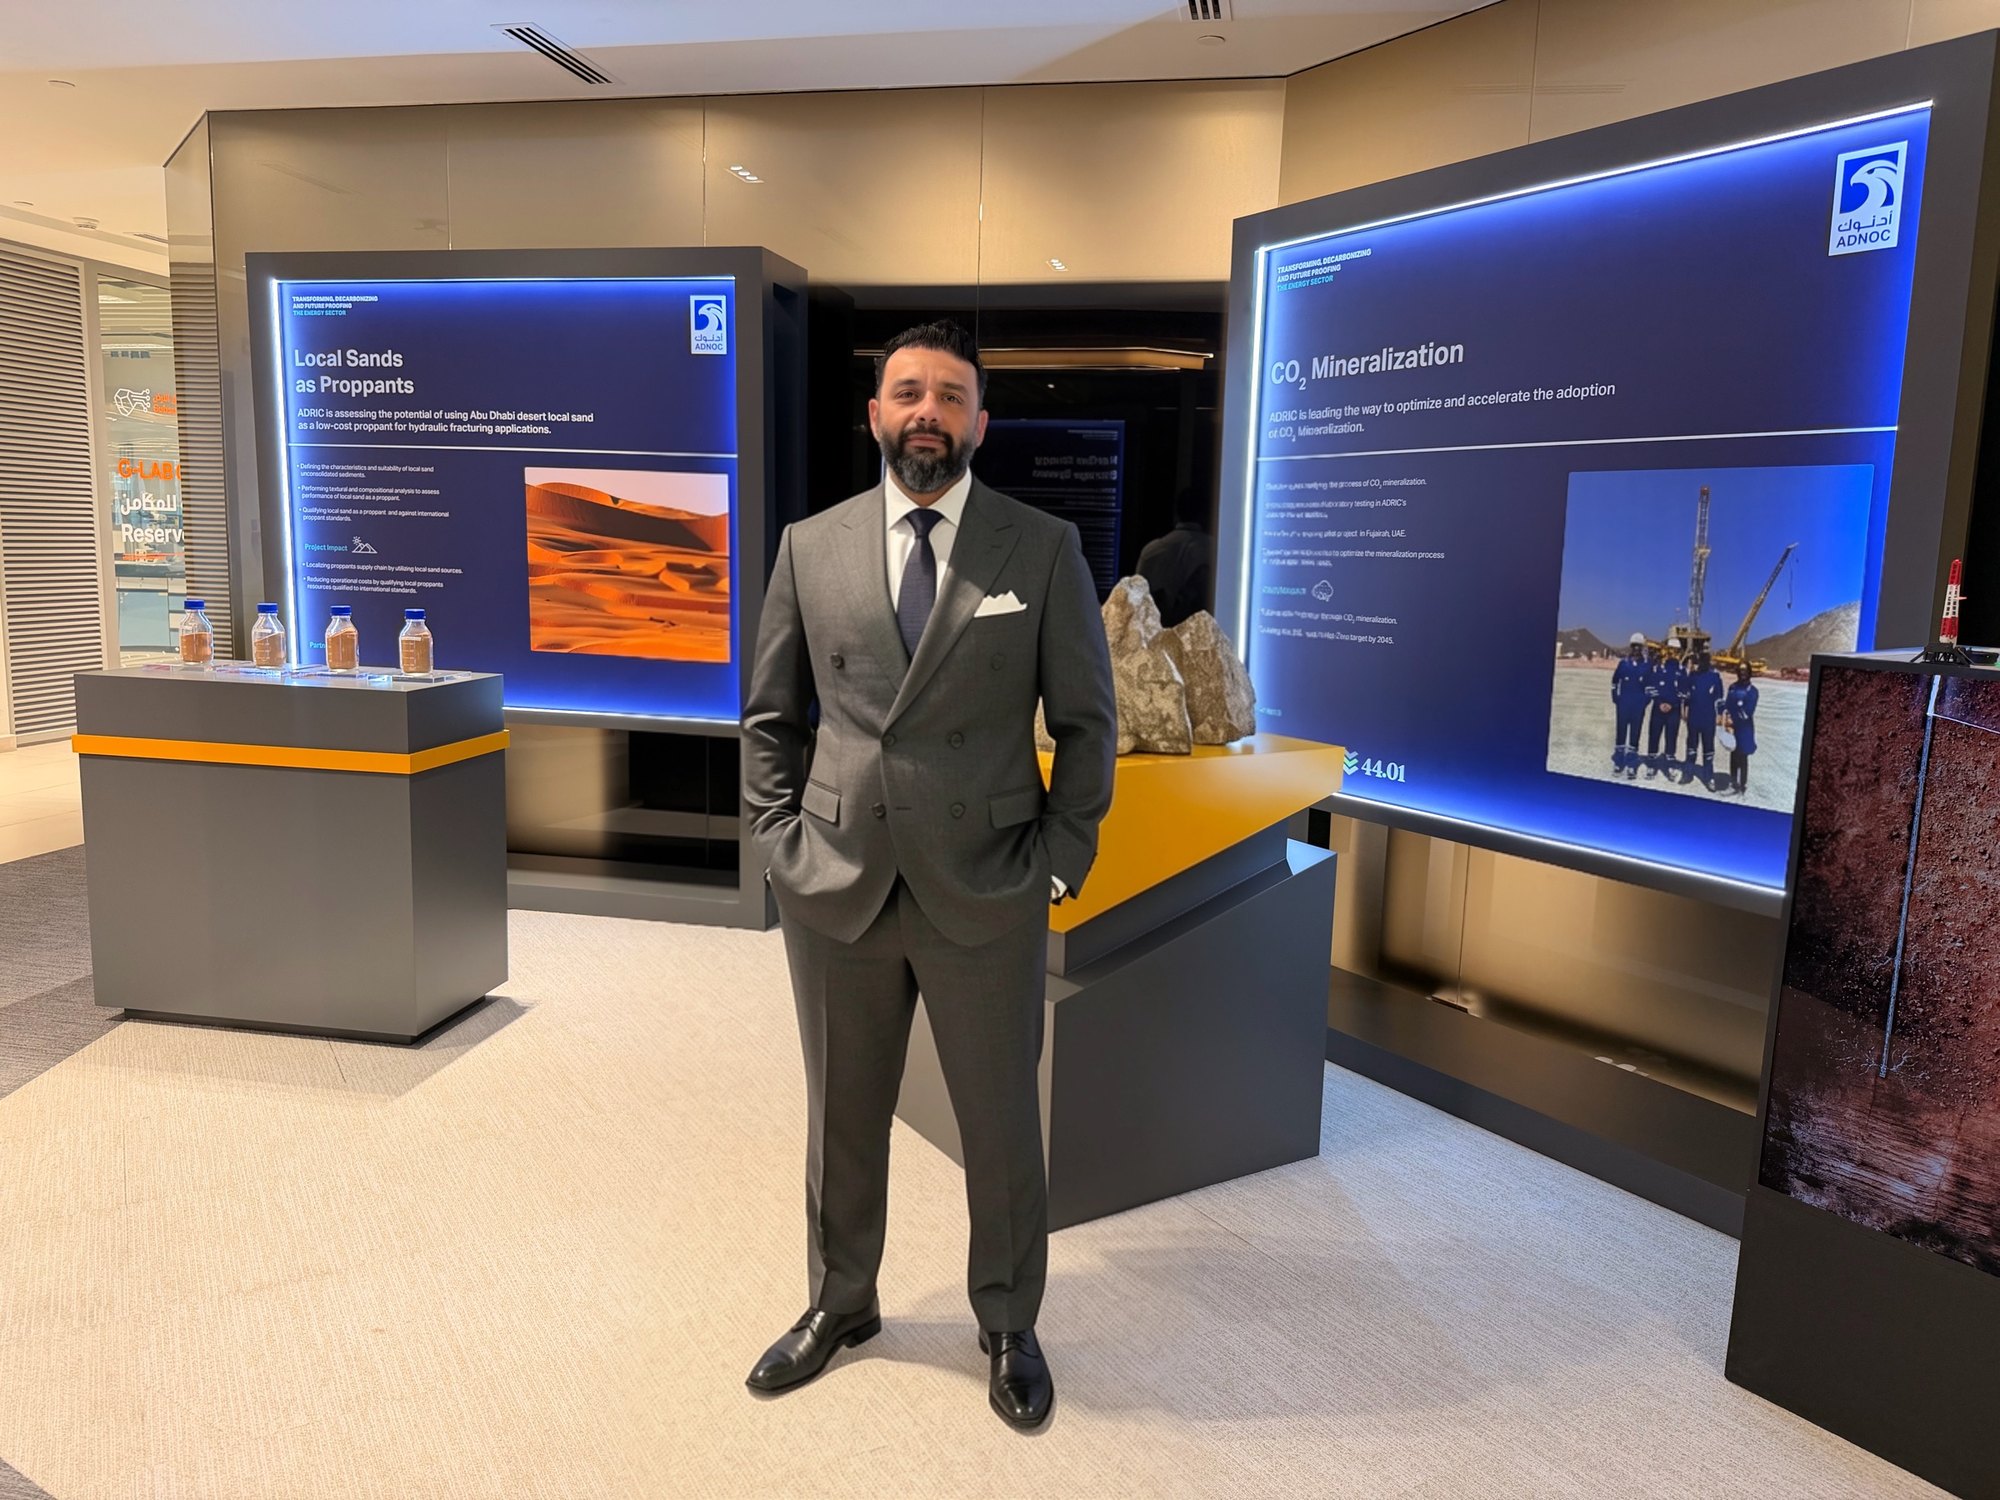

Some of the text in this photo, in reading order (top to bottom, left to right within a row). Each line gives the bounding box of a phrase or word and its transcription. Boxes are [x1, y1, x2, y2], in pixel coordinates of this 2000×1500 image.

[1836, 229, 1891, 248] ADNOC
[1322, 248, 1372, 264] DECARBONIZING
[1277, 264, 1342, 283] AND FUTURE PROOFING
[1277, 275, 1334, 292] THE ENERGY SECTOR
[294, 349, 404, 367] Local Sands
[1311, 342, 1464, 380] Mineralization
[296, 376, 414, 398] as Proppants
[1269, 382, 1616, 423] ADRIC is leading the way to optimize and accelerate the adoption
[298, 408, 594, 422] ADRIC is assessing the potential of using Abu Dhabi desert local sand
[298, 422, 308, 430] as
[316, 421, 352, 430] low-cost
[354, 422, 394, 432] proppant
[394, 422, 408, 431] for
[408, 422, 449, 433] hydraulic
[450, 423, 494, 434] fracturing
[494, 424, 552, 434] applications.
[1298, 421, 1365, 437] Mineralization.
[118, 457, 174, 480] G-LAB
[1382, 478, 1428, 486] mineralization.
[1354, 500, 1374, 508] testing
[1382, 498, 1407, 507] ADRIC's
[122, 524, 184, 543] Reserv
[304, 543, 326, 552] Project
[1376, 550, 1418, 559] mineralization
[1418, 551, 1445, 560] process
[1368, 636, 1376, 644] by
[1361, 758, 1406, 783] 44.01
